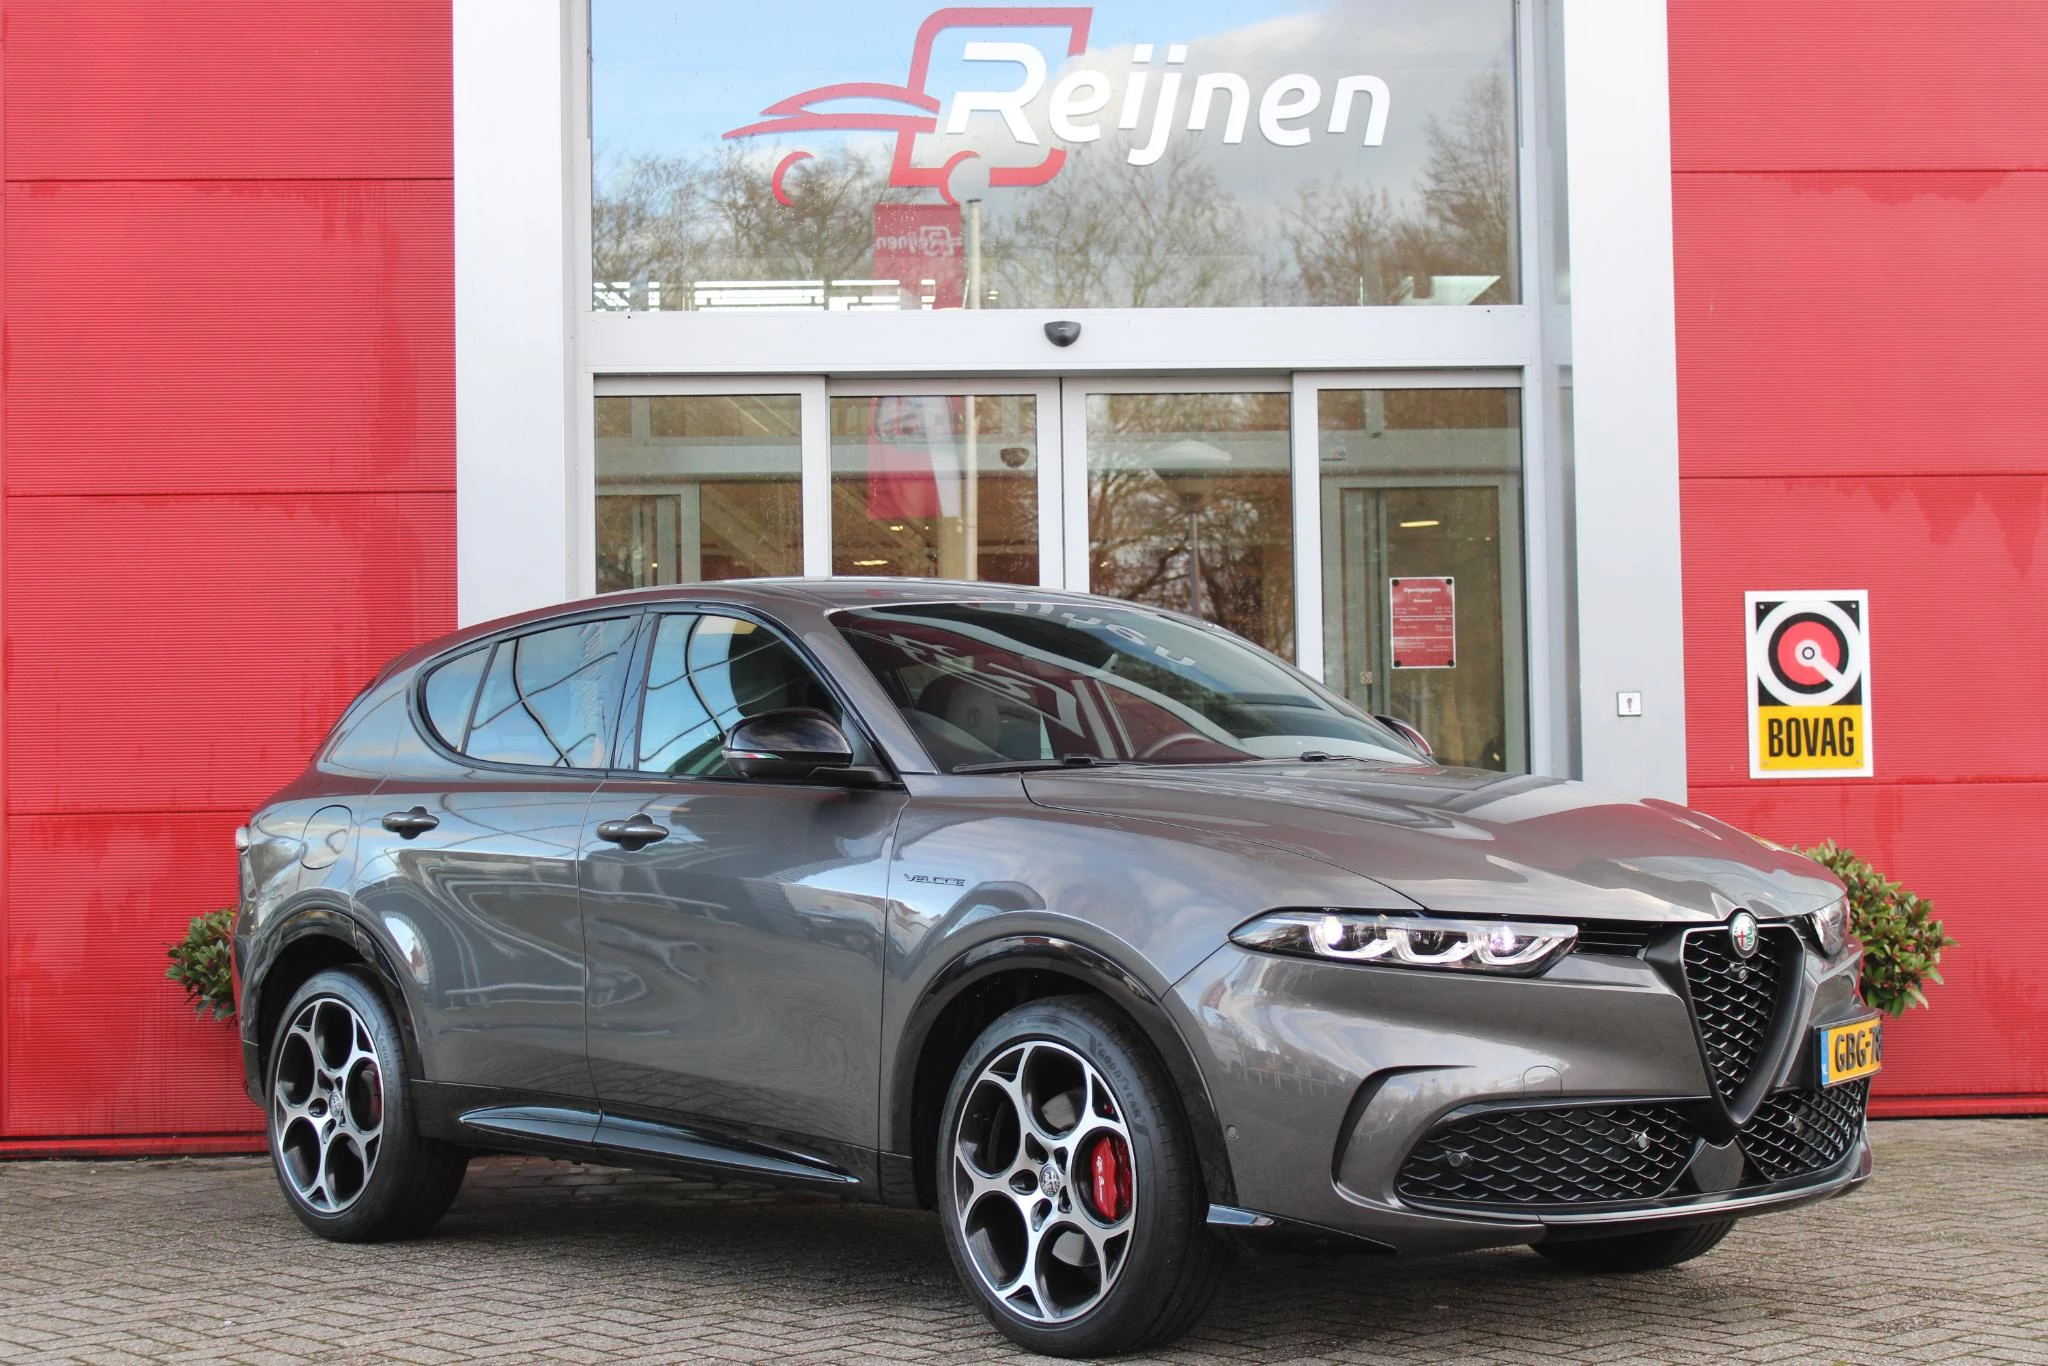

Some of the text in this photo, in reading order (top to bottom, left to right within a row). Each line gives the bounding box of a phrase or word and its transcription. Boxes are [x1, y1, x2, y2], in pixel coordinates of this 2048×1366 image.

[945, 42, 1390, 166] Reijnen
[1767, 716, 1855, 758] BOVAG
[903, 873, 966, 887] VELOCE
